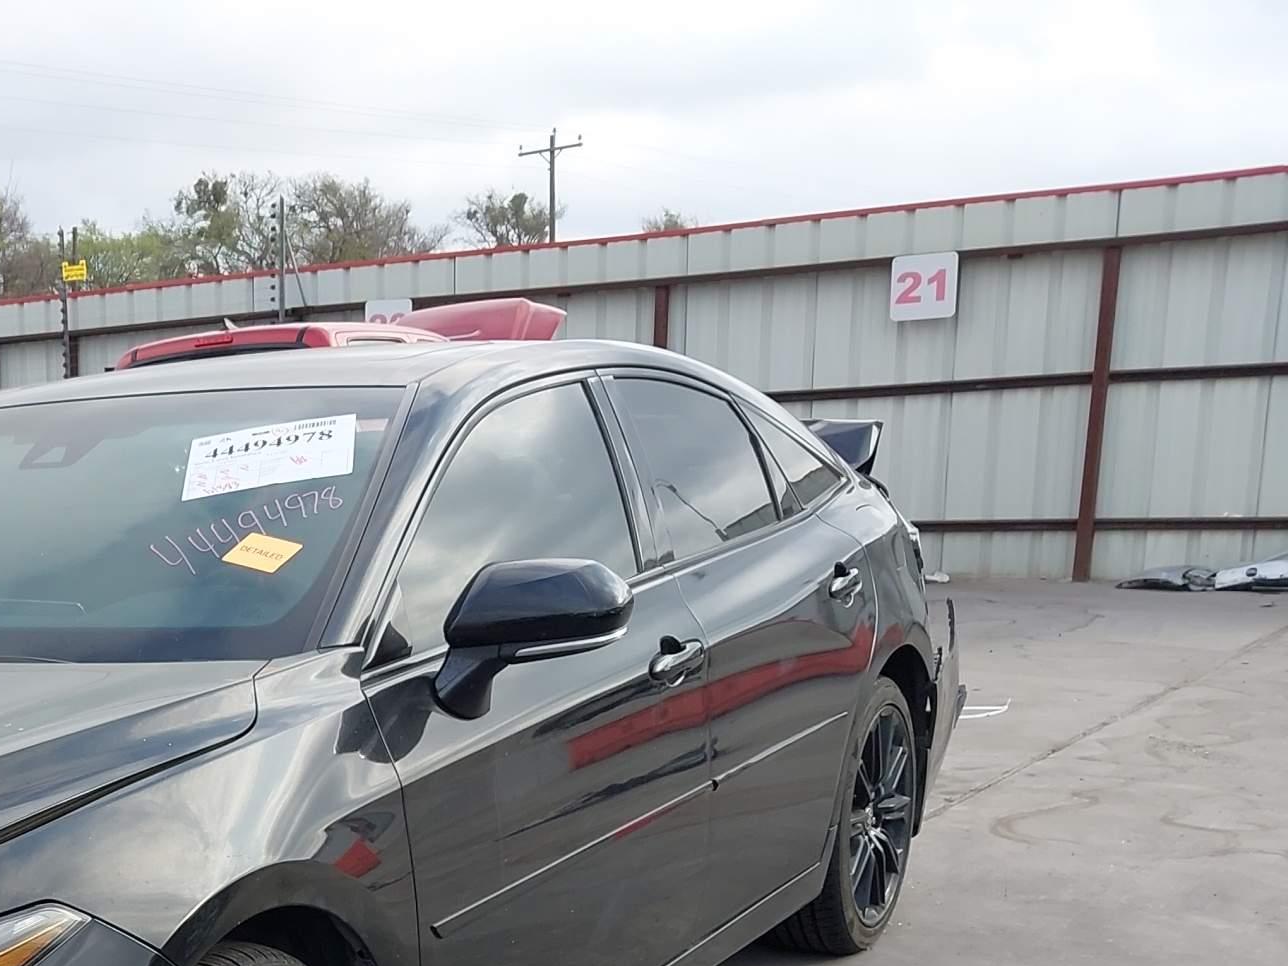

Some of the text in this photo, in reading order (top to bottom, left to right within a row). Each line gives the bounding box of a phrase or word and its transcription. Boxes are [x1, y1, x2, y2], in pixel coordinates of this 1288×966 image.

[895, 268, 947, 305] 21
[204, 429, 333, 459] 44494978
[150, 486, 343, 575] 44494978
[240, 544, 283, 561] DETAILED
